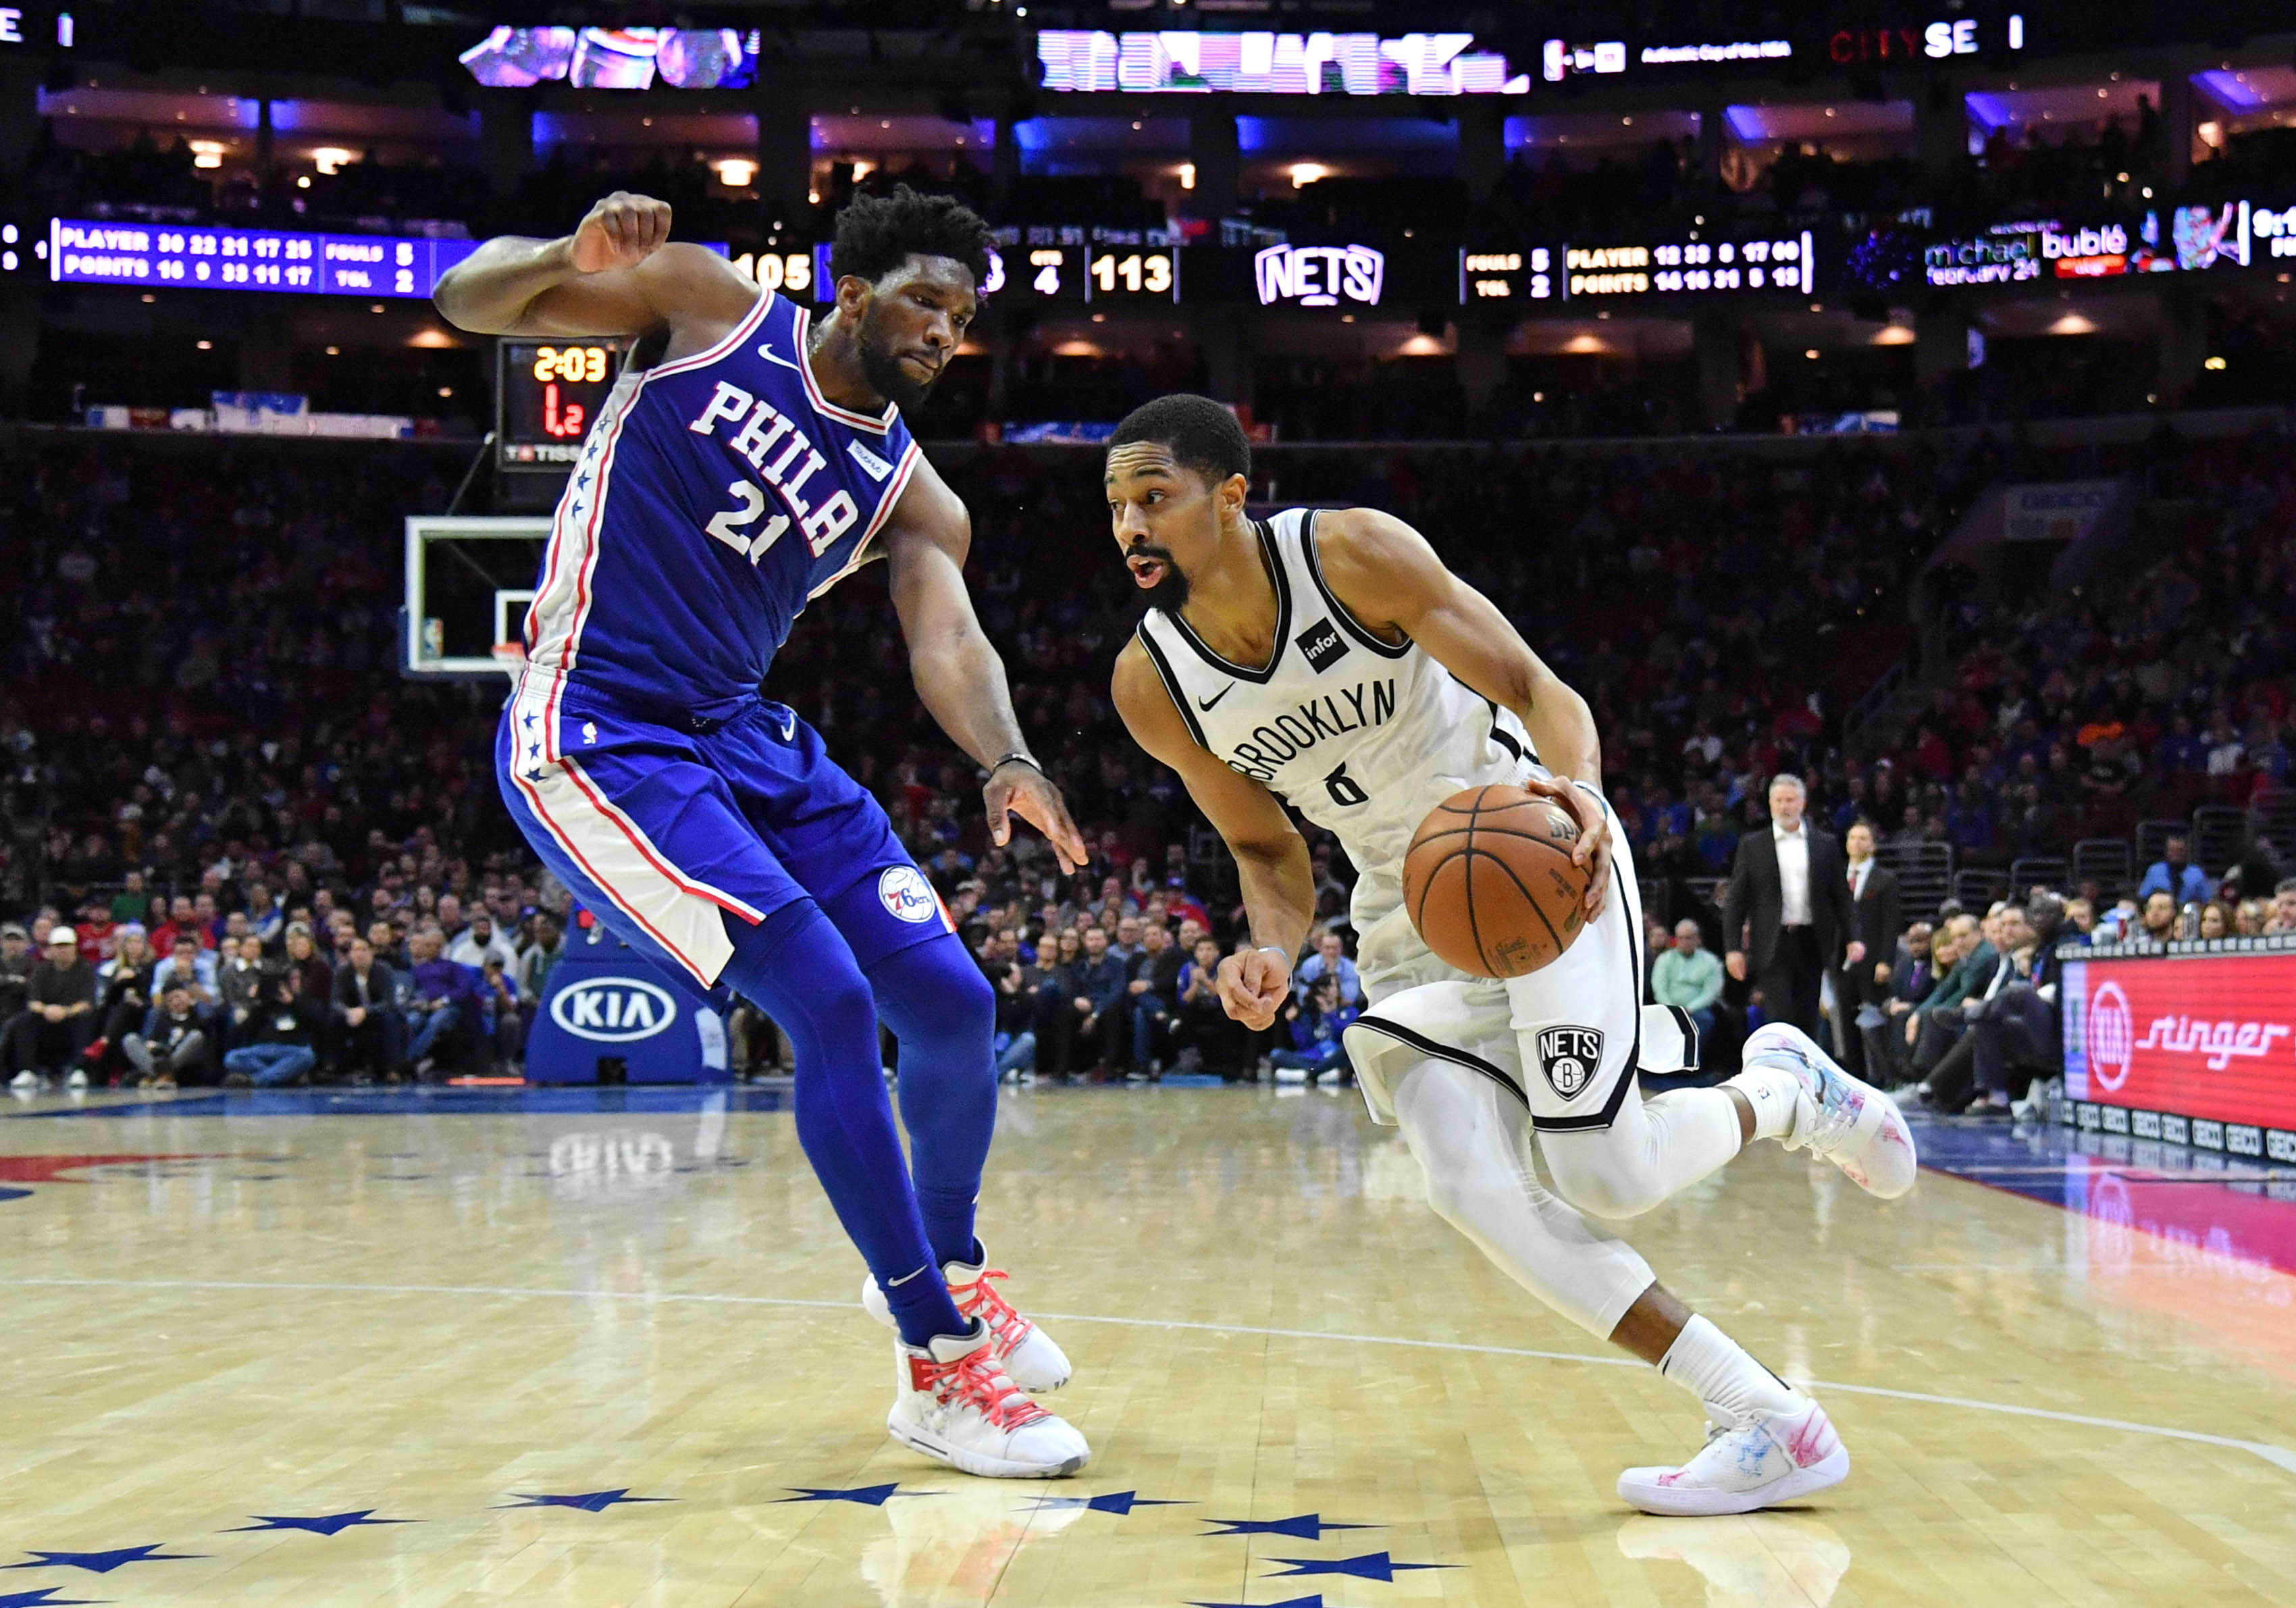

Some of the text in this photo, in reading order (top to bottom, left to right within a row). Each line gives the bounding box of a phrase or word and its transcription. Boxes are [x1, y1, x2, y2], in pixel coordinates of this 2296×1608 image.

[60, 227, 149, 252] PLAYER
[189, 234, 217, 255] 22
[253, 238, 281, 258] 17
[325, 242, 384, 263] FOULS
[1567, 246, 1650, 269] PLAYER
[1742, 241, 1771, 263] 17
[64, 254, 149, 278] POINTS
[253, 263, 280, 284] 11
[284, 265, 313, 286] 17
[732, 253, 811, 291] 105
[1091, 254, 1172, 292] 113
[1265, 246, 1374, 303] NETS
[1465, 253, 1522, 271] FOULS
[395, 269, 414, 292] 2
[1033, 265, 1060, 295] 4
[1530, 274, 1550, 299] 2
[1571, 272, 1650, 295] POINTS
[533, 346, 606, 382] 2:03
[687, 380, 859, 559] PHILA
[704, 479, 791, 567] 21
[1305, 631, 1338, 660] infor
[1227, 678, 1395, 781] BROOKLYN
[571, 991, 655, 1028] KIA
[1540, 1029, 1598, 1062] NETS
[2135, 1014, 2291, 1071] stinger
[1562, 1062, 1573, 1088] B
